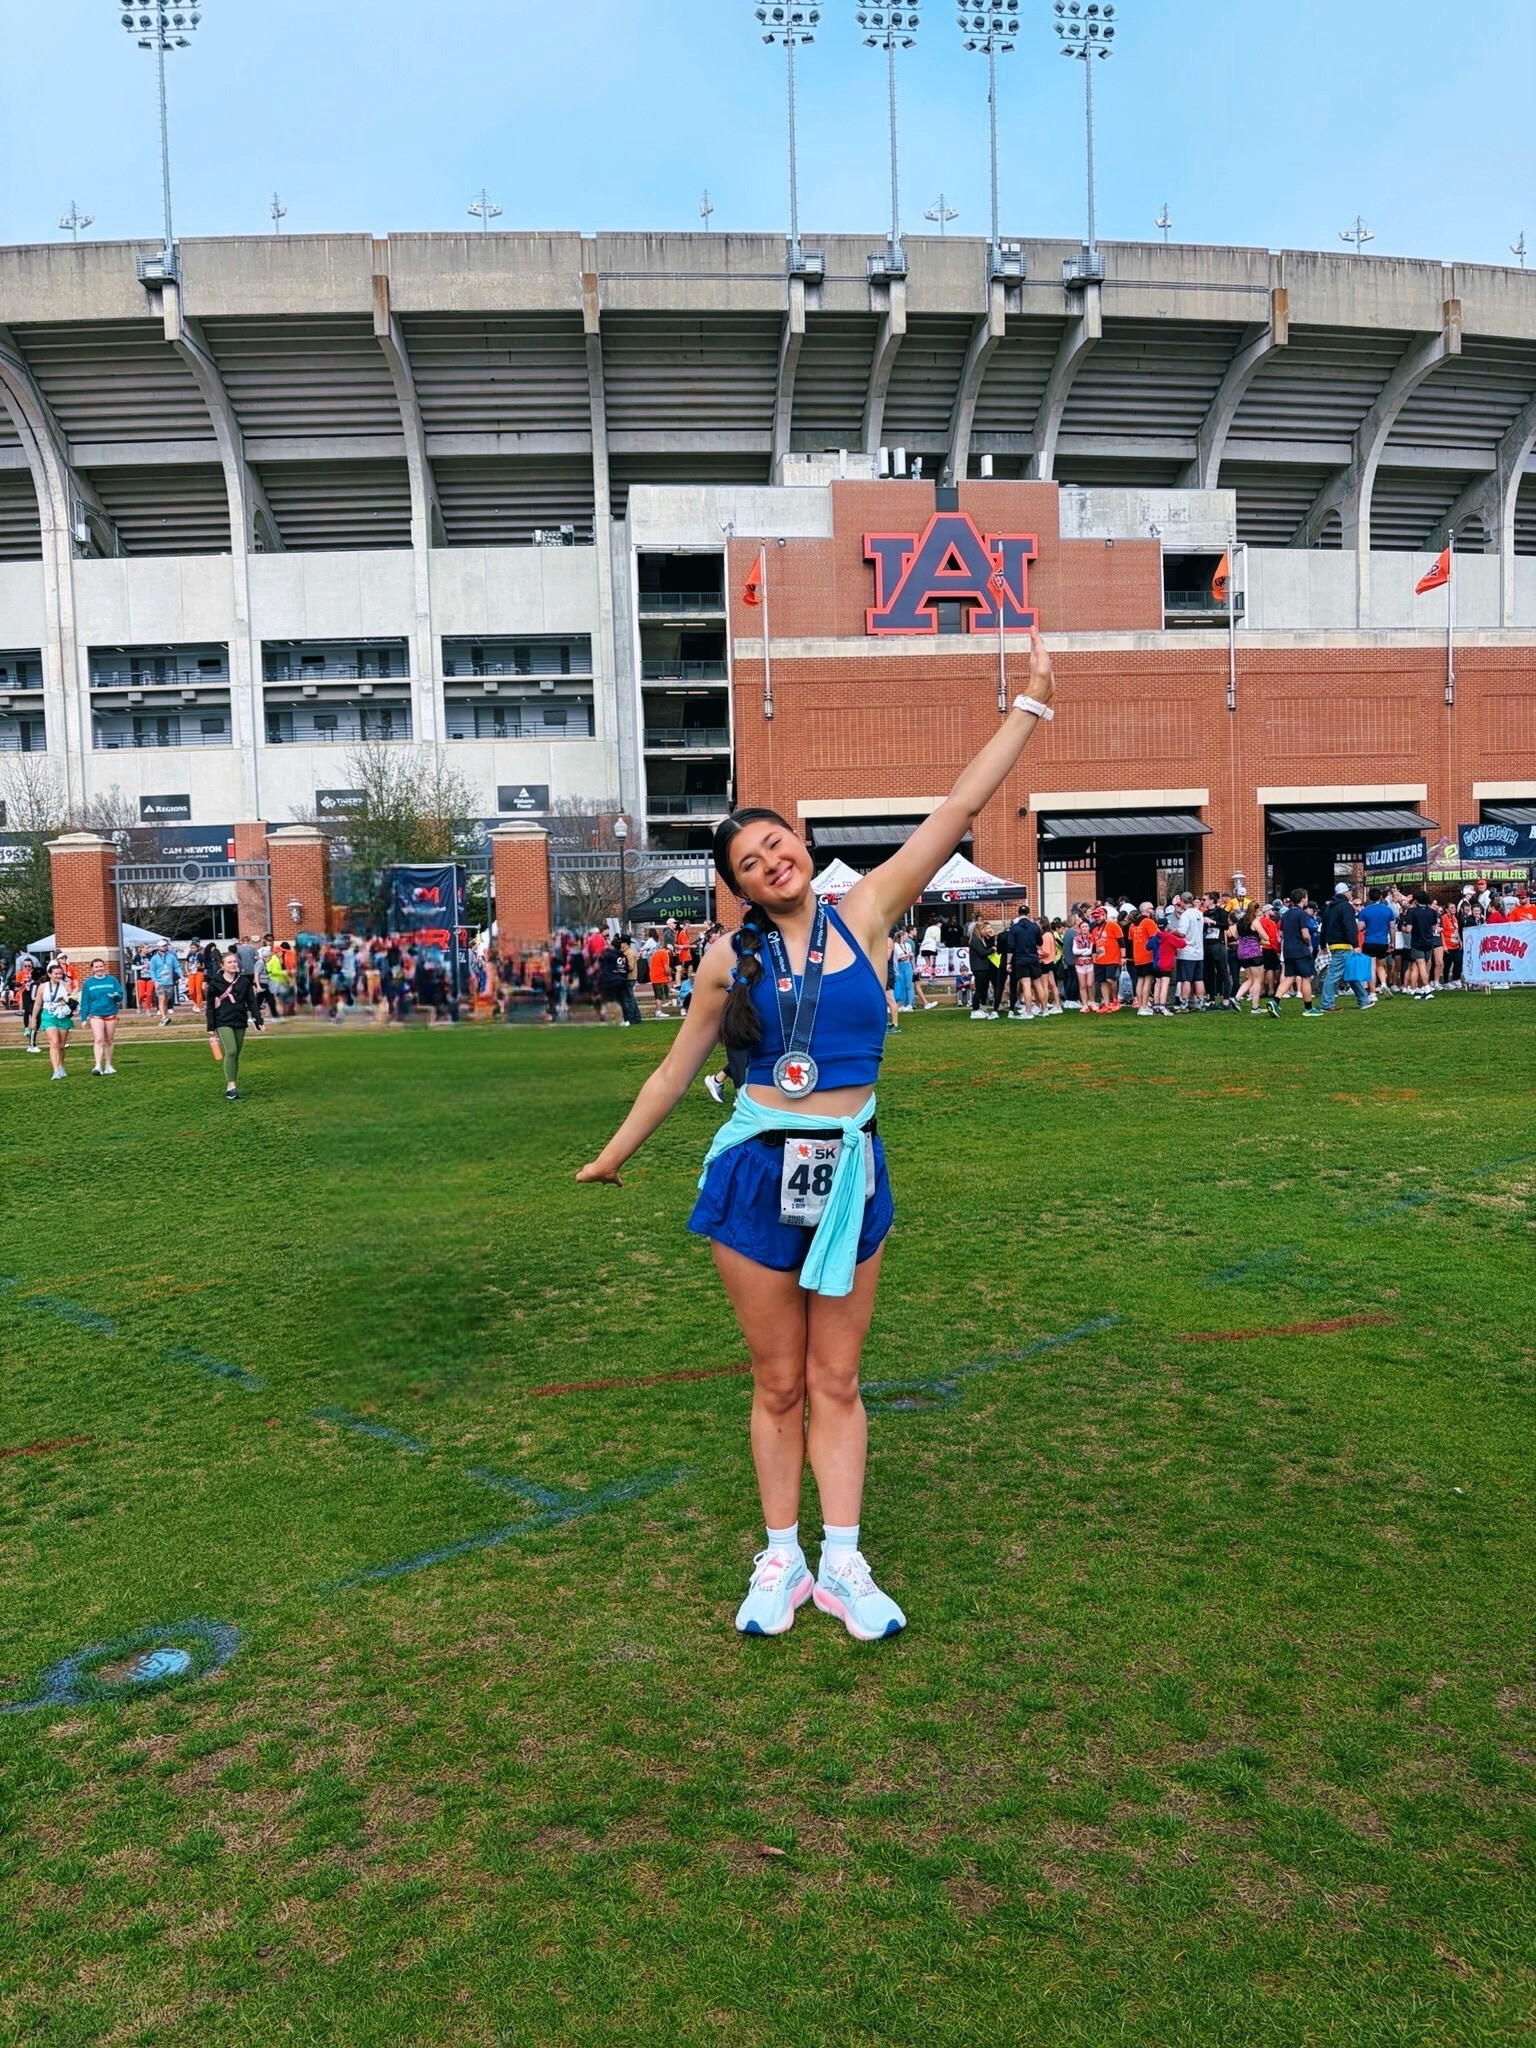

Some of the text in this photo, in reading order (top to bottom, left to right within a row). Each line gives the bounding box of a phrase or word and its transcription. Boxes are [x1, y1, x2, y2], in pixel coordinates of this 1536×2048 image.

[184, 845, 222, 853] NEWTON
[1365, 843, 1423, 866] VOLUNTEERS
[1428, 871, 1443, 882] FOR
[1493, 869, 1527, 880] ATHLETES
[660, 908, 698, 918] Publix
[815, 1147, 836, 1160] 5K
